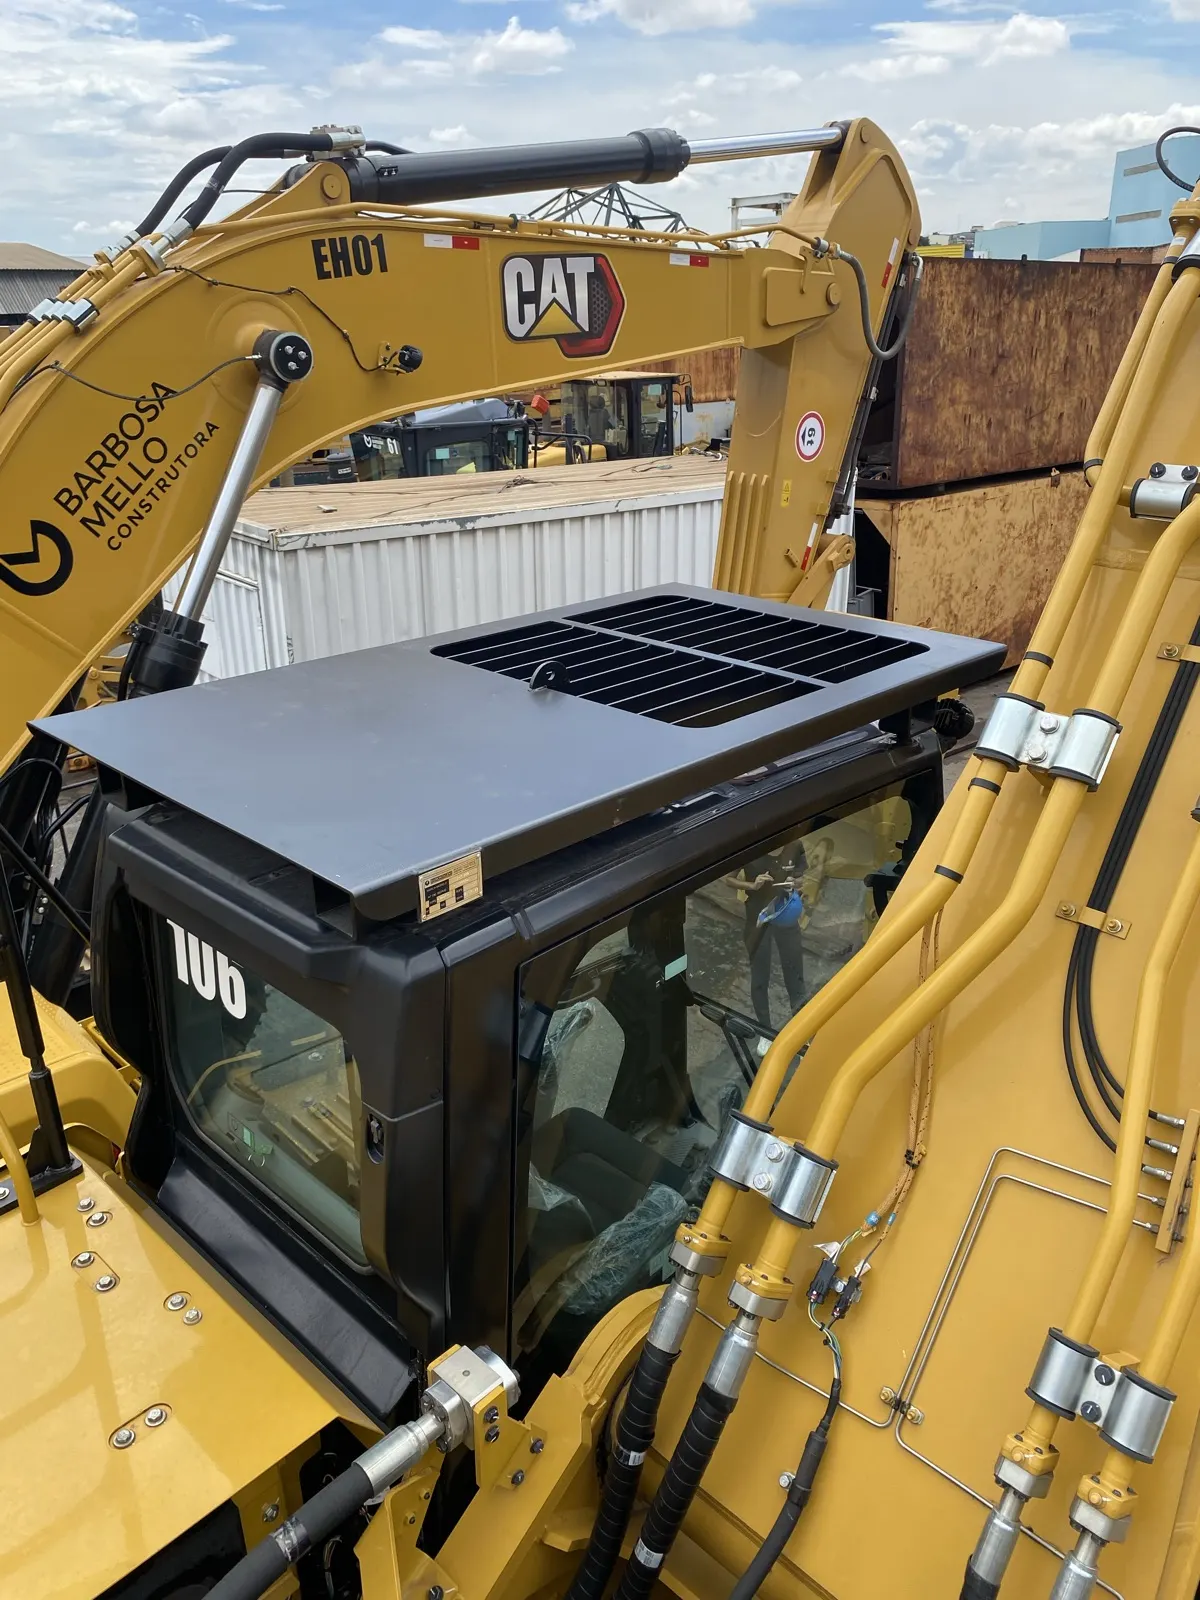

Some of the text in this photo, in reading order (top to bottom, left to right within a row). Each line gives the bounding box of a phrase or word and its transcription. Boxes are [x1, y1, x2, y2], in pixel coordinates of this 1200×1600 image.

[311, 233, 388, 280] EH01
[503, 256, 595, 338] CAT
[53, 381, 179, 516] BARBOSA
[79, 437, 168, 538] MELLO
[107, 421, 221, 551] CONSTRUTORA
[386, 437, 399, 455] 61
